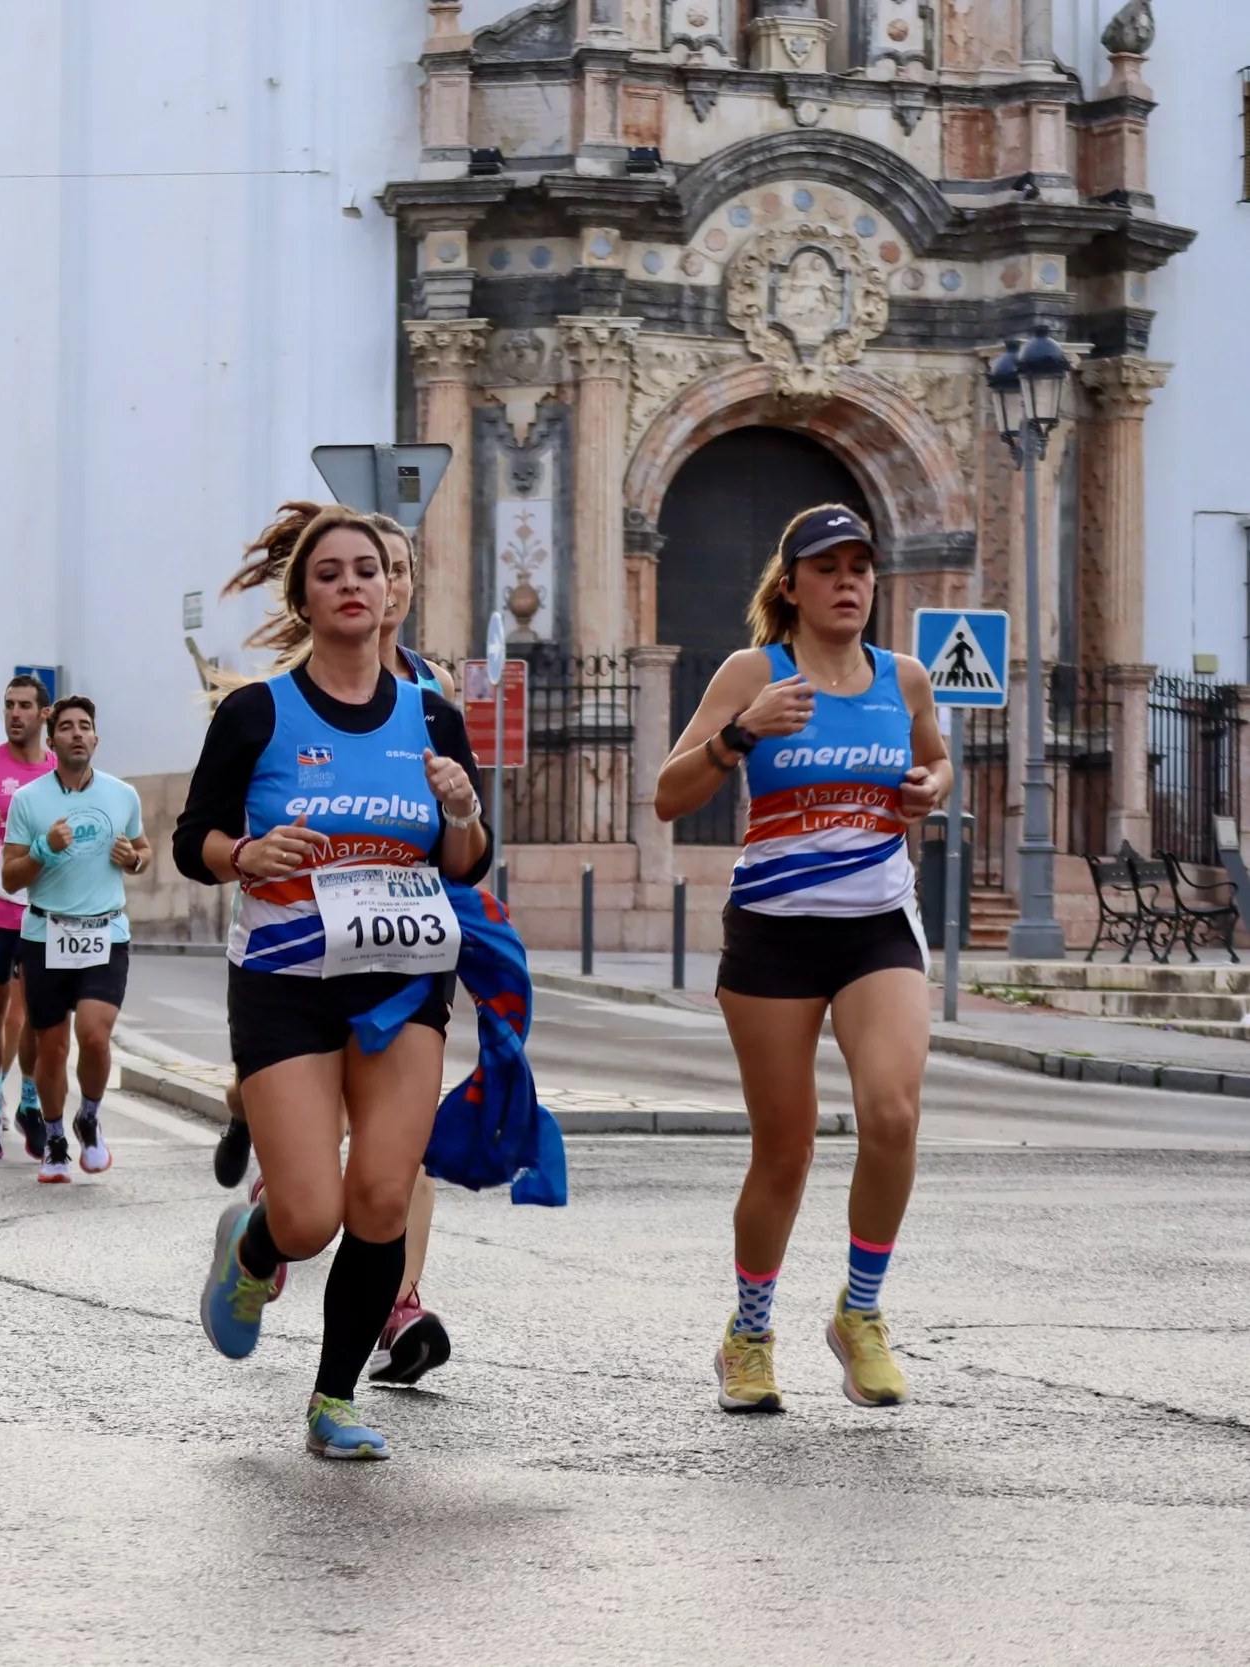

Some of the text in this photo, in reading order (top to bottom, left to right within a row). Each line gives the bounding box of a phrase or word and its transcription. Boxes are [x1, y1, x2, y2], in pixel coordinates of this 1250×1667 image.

[773, 743, 906, 770] enerplus
[285, 795, 430, 823] enerplus
[795, 786, 890, 809] Maratón
[310, 841, 414, 864] Maratón
[383, 869, 414, 885] 2024
[347, 914, 446, 949] 1003
[57, 936, 104, 954] 1025
